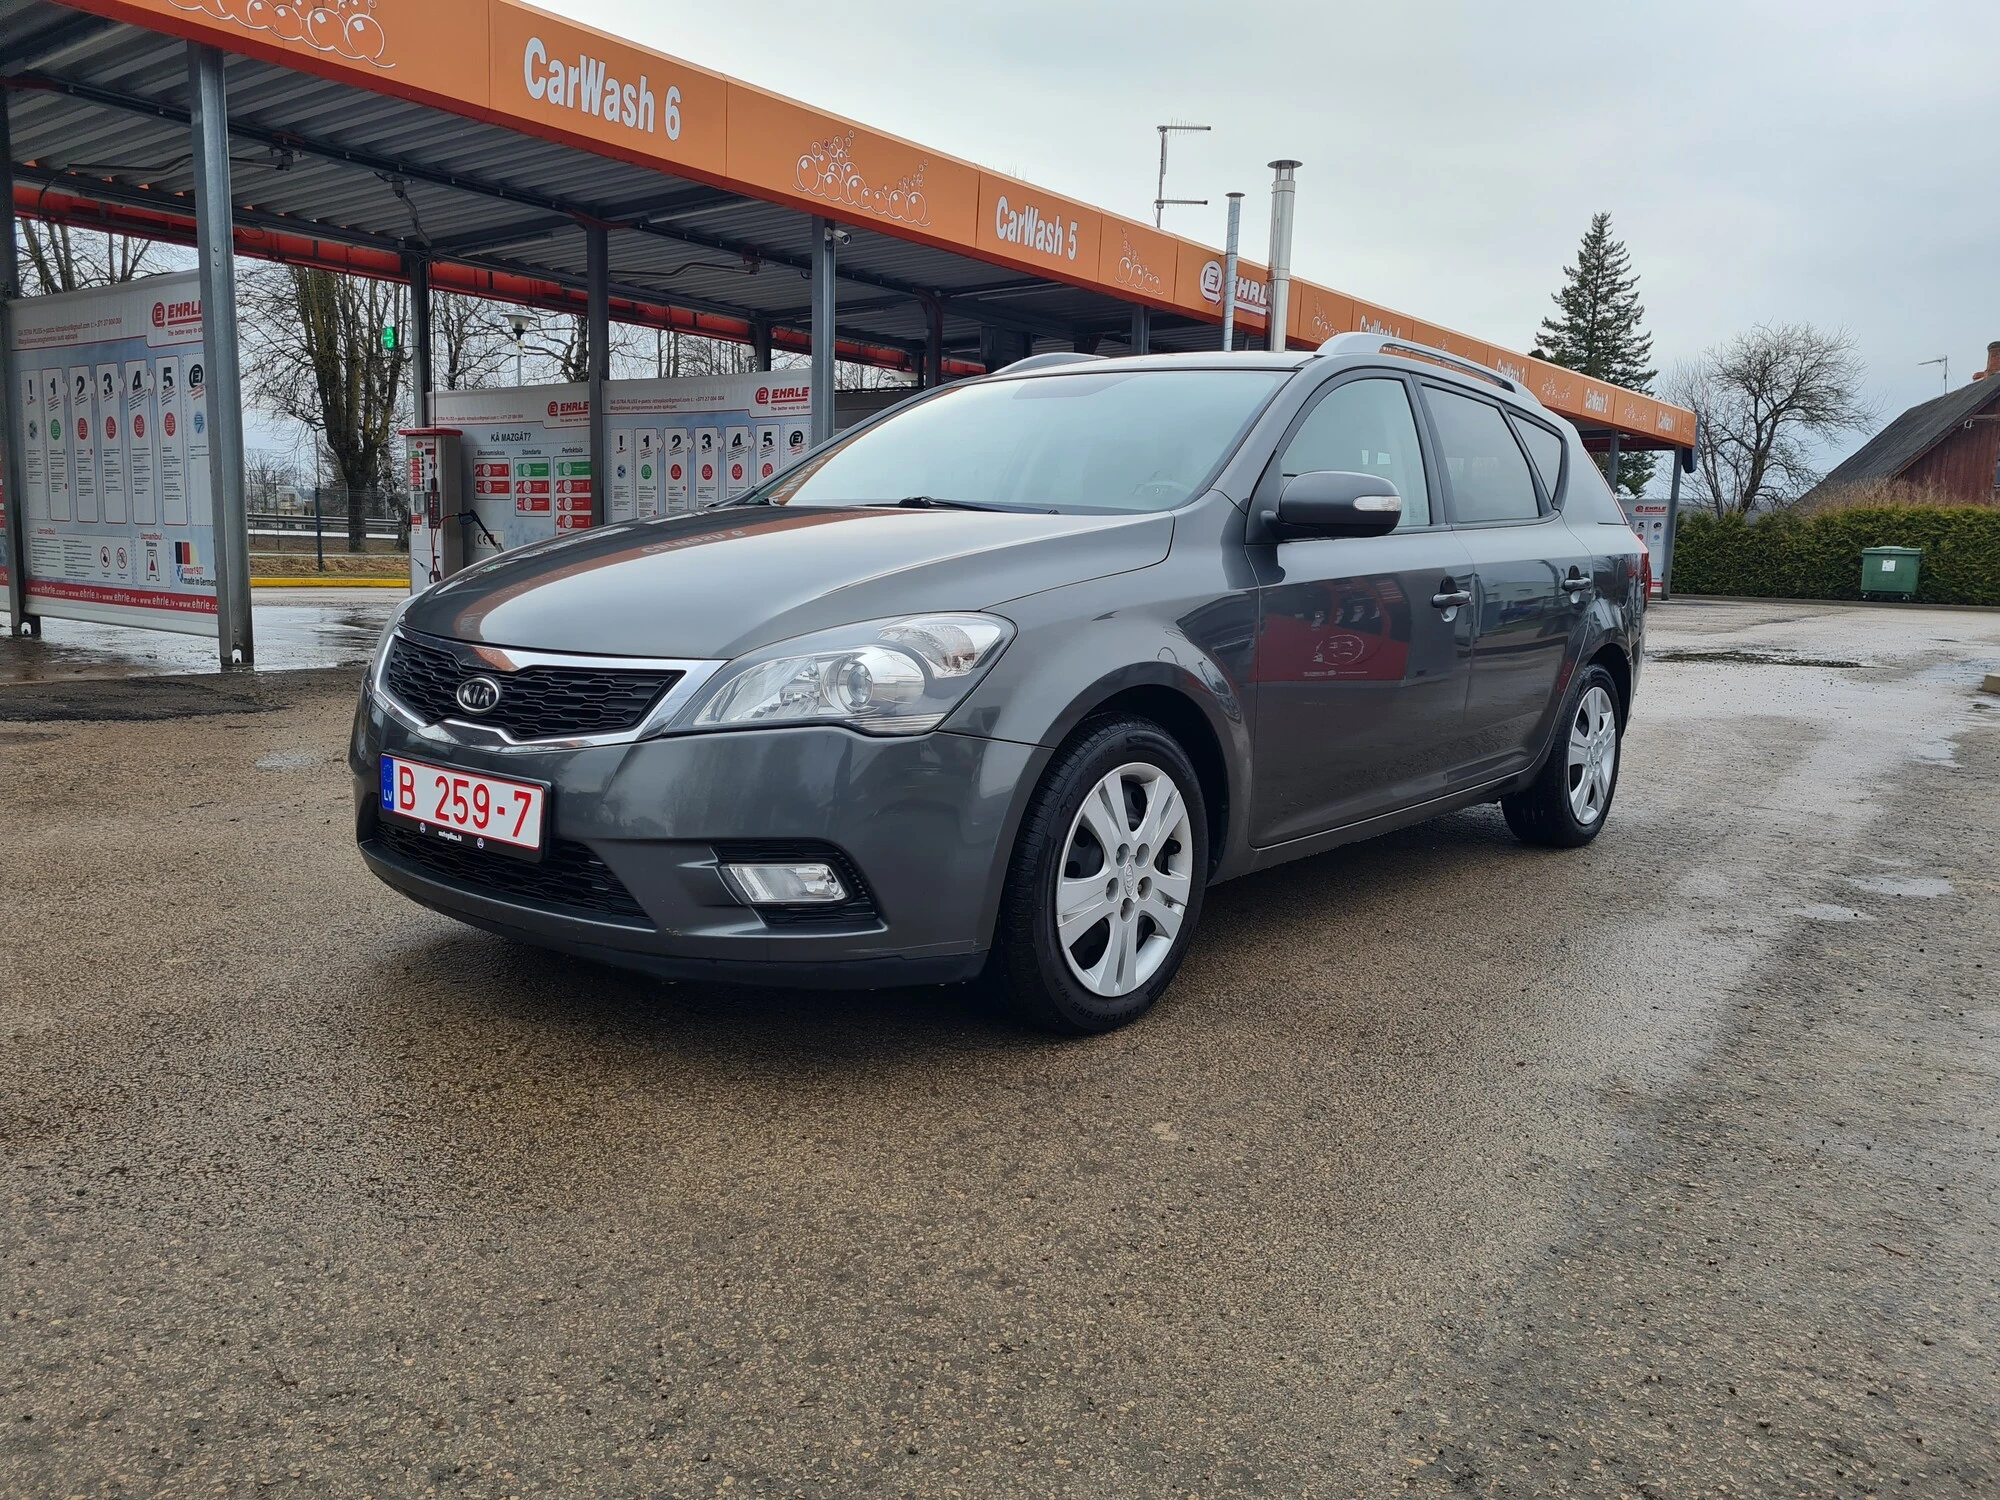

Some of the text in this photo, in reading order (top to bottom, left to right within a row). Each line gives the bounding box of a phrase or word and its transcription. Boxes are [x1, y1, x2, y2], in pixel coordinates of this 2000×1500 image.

[524, 36, 682, 141] CarWash 6
[995, 195, 1078, 261] CarWash 5
[50, 377, 56, 395] 1
[76, 375, 85, 395] 2
[103, 372, 113, 396] 3
[132, 370, 142, 391] 4
[163, 366, 173, 390] 5
[771, 386, 810, 399] EHRLE
[560, 400, 590, 411] EHRLE
[490, 430, 531, 442] KĀ MAZGĀT?
[642, 434, 650, 449] 1
[671, 434, 682, 450] 2
[701, 433, 712, 451] 3
[732, 432, 742, 448] 4
[762, 431, 773, 448] 5
[31, 584, 66, 596] www.ehrle.com
[462, 684, 490, 707] KIA
[383, 789, 393, 802] LV
[399, 765, 532, 838] B 259-7
